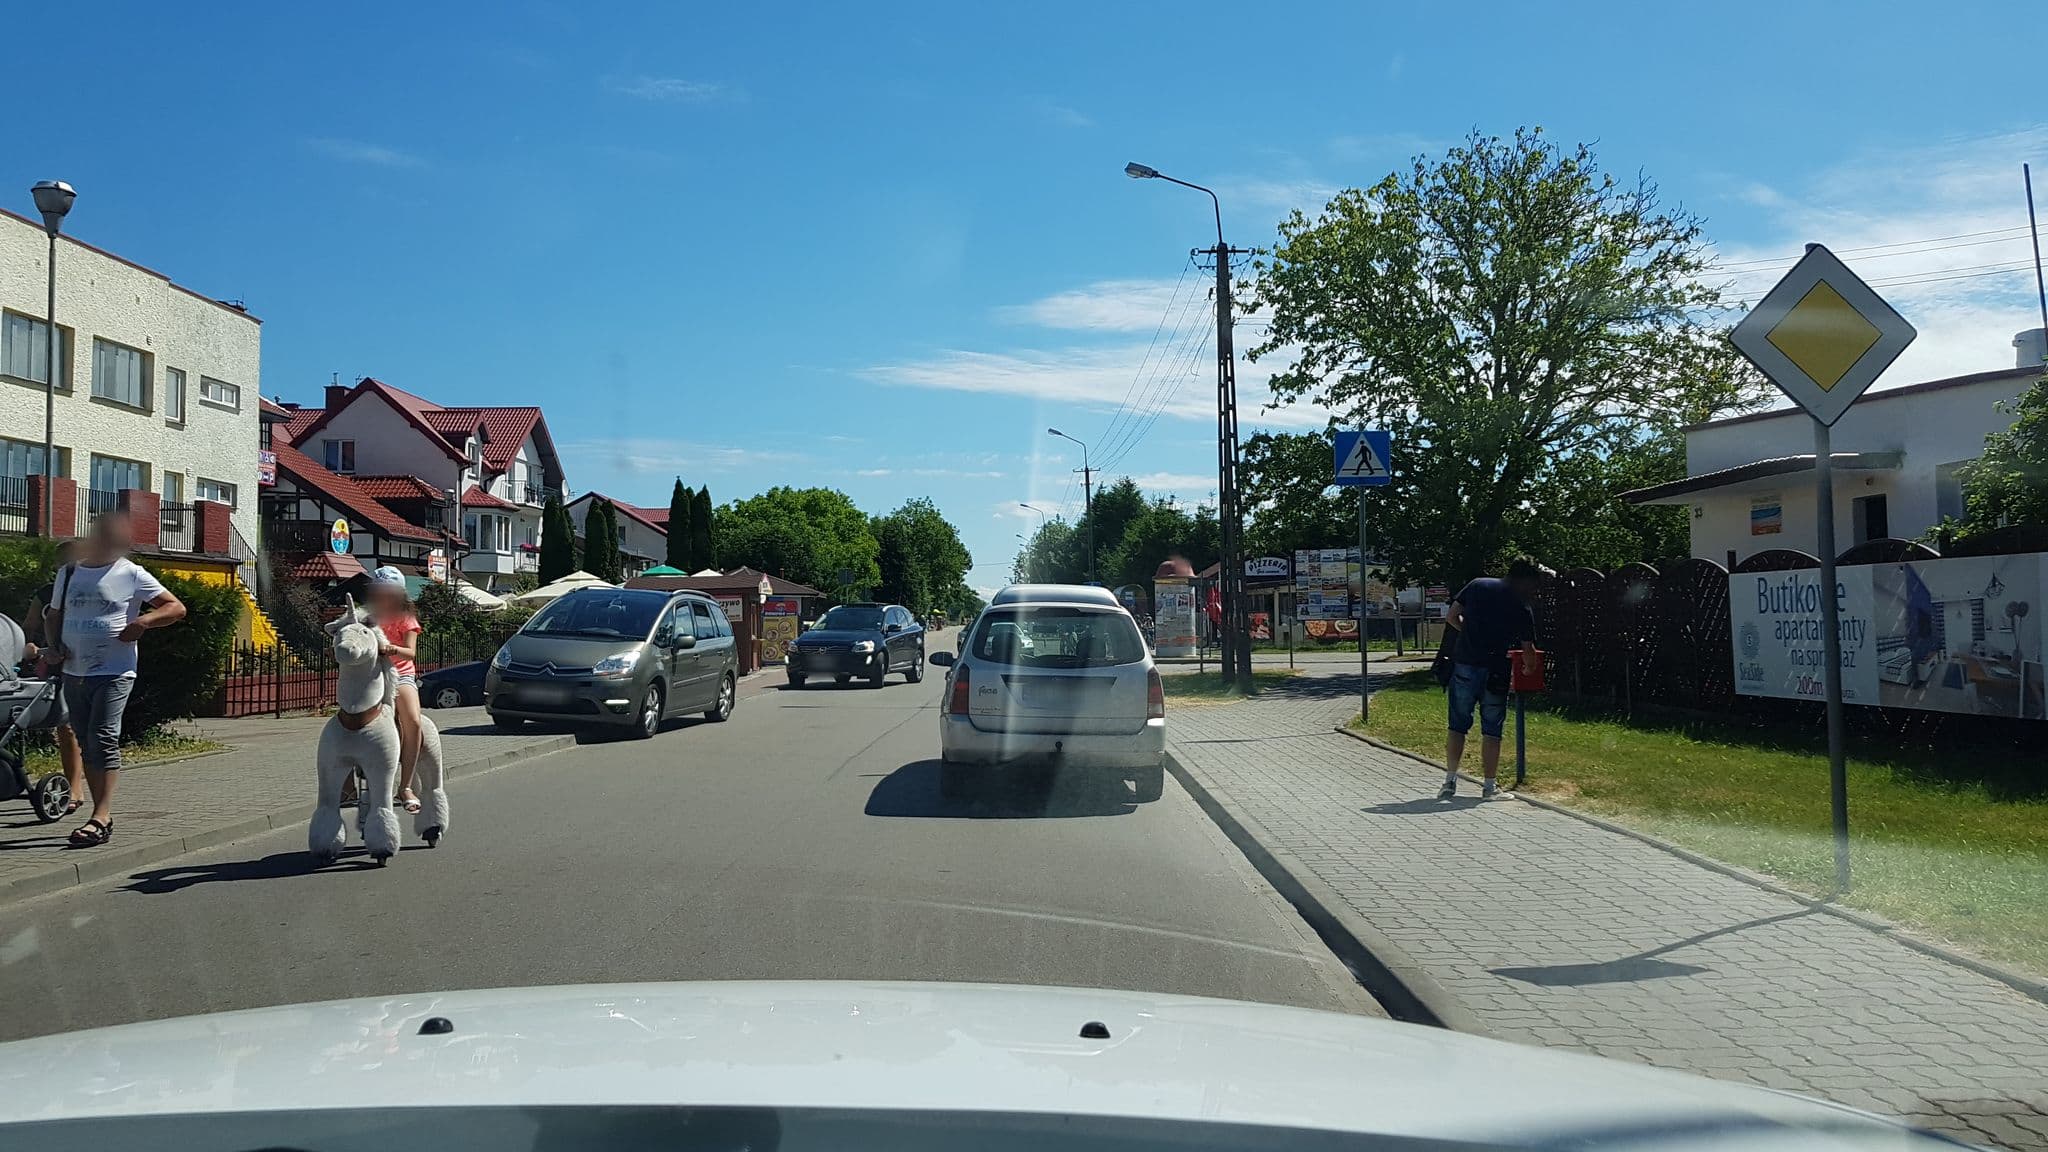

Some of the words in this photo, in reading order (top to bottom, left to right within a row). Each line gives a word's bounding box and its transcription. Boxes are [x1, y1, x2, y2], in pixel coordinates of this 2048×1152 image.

[1248, 559, 1287, 572] PIZZERIA
[1757, 575, 1846, 614] Butikoe
[1775, 616, 1866, 648] apartanty
[1791, 648, 1804, 665] na
[1807, 646, 1856, 671] spraż
